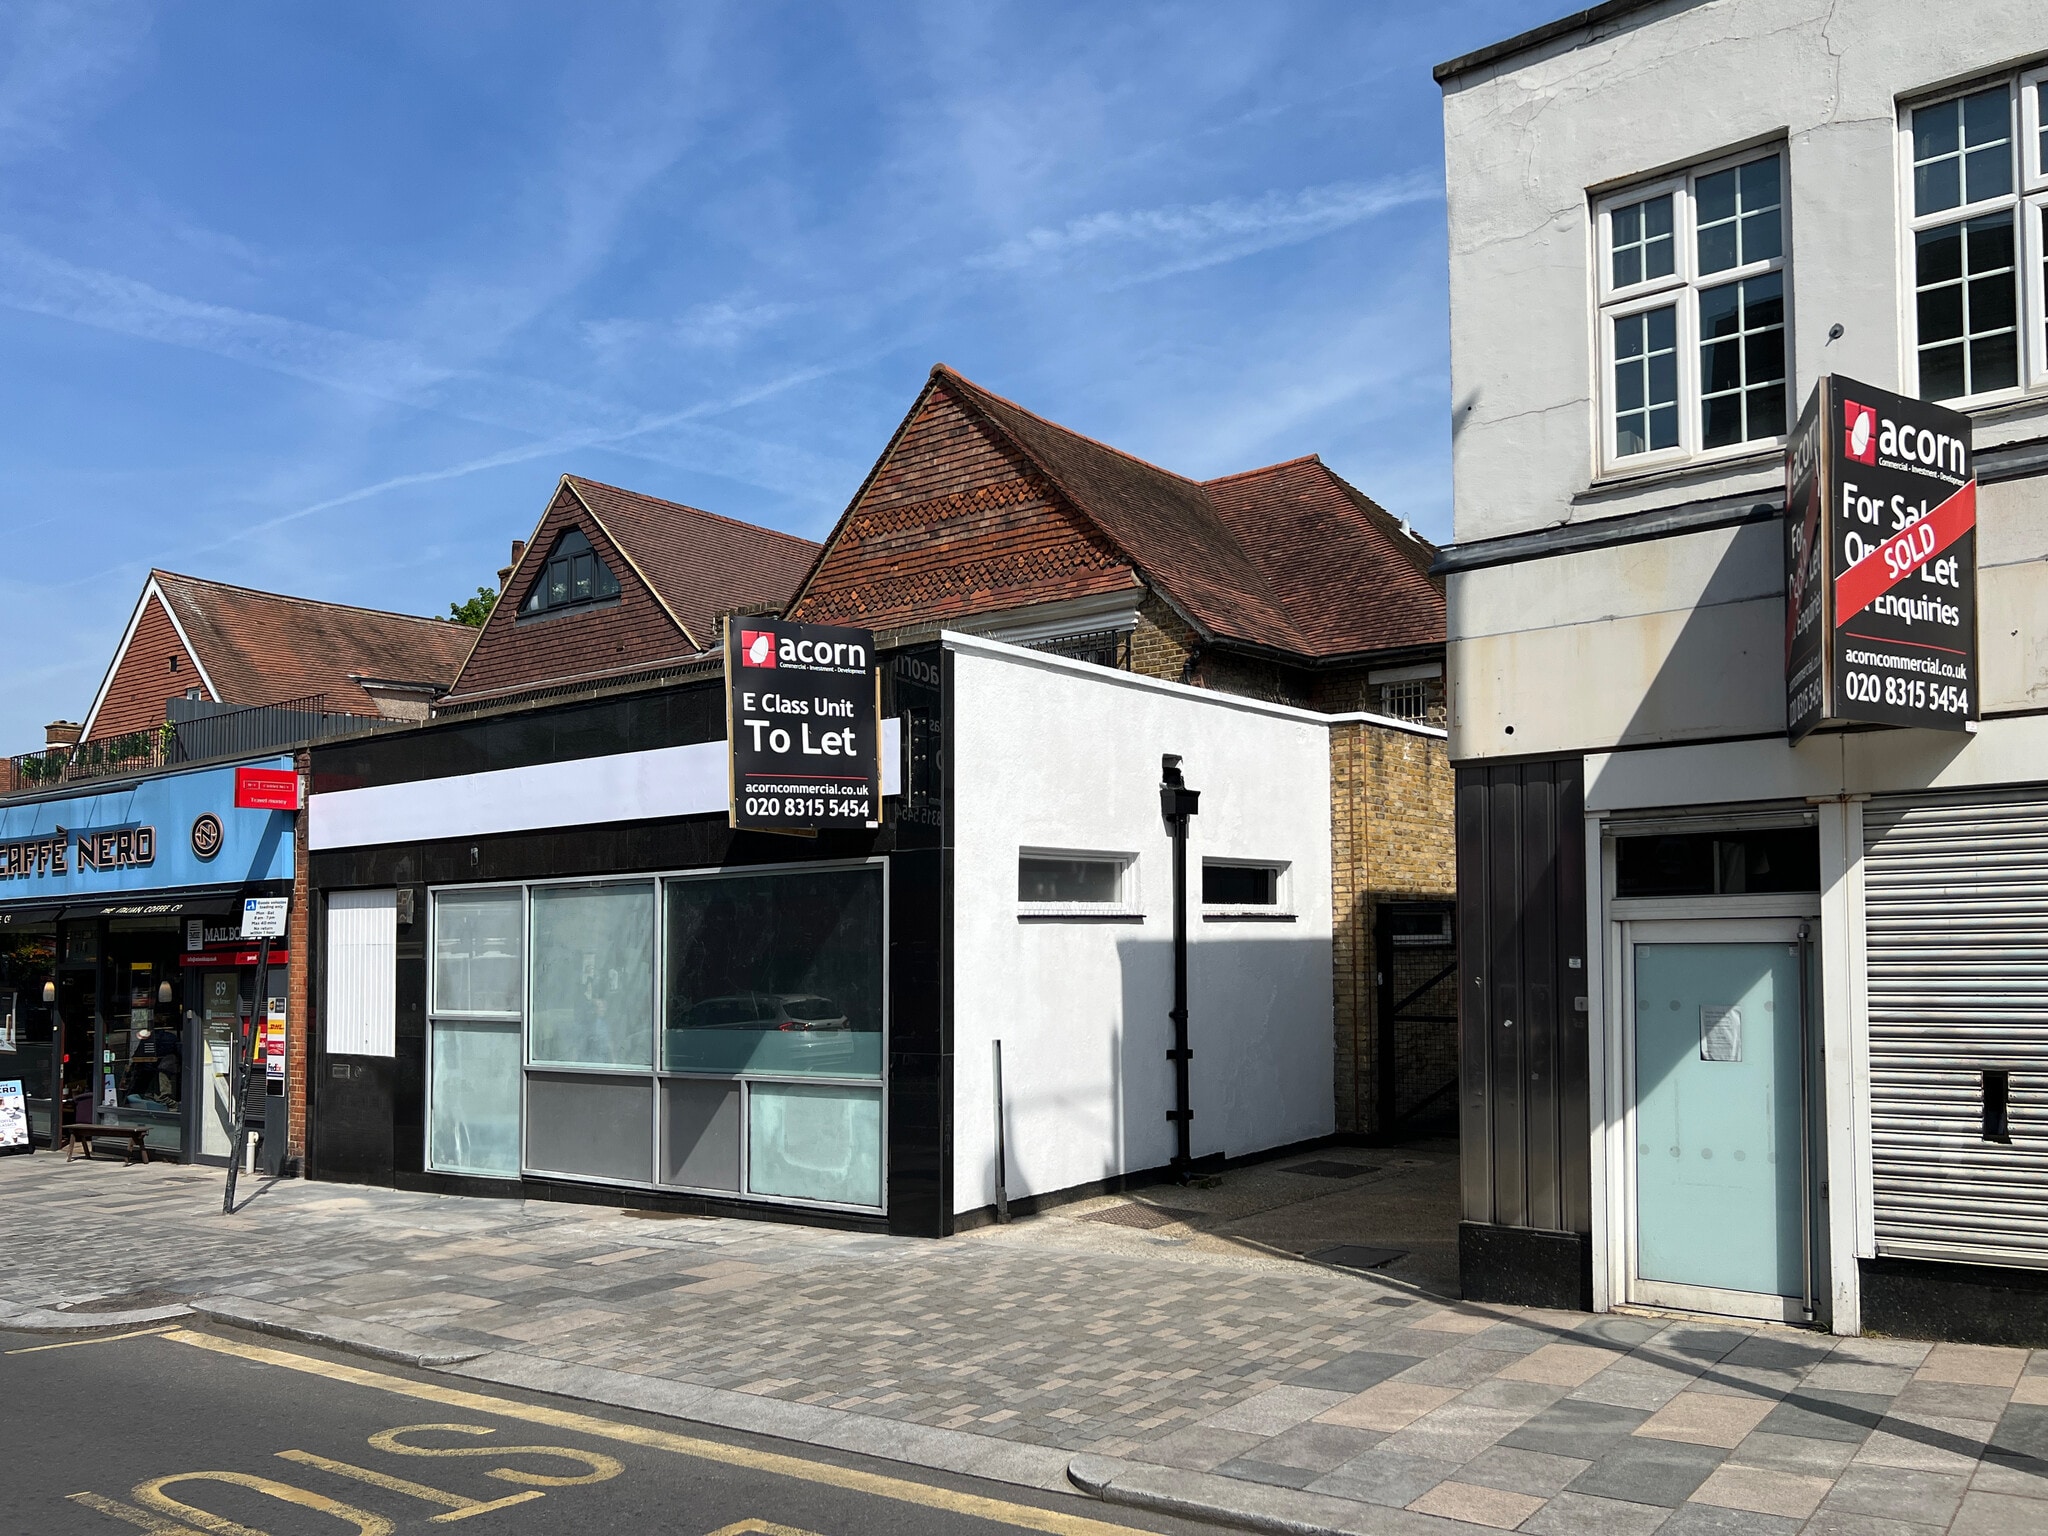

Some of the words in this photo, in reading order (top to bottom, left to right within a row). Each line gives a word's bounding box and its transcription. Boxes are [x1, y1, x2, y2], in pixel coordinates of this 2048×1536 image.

[1879, 418, 1965, 475] acorn
[1878, 457, 1908, 472] Commercial
[1911, 465, 1937, 478] Investment
[1843, 482, 1884, 525] For
[1884, 523, 1935, 579] SOLD
[1921, 555, 1959, 588] Let
[1874, 594, 1959, 627] Enquiries
[779, 638, 865, 667] acorn
[1845, 649, 1967, 680] acorncommercial.co.uk
[779, 662, 806, 670] Commercial
[809, 665, 834, 673] Investment
[837, 667, 866, 675] Development
[743, 692, 756, 711] E
[761, 693, 809, 715] Class
[814, 697, 854, 718] Unit
[1846, 671, 1881, 703] 020
[1885, 676, 1925, 709] 8315
[1929, 682, 1968, 715] 5454
[743, 719, 791, 753] To
[801, 722, 857, 756] Let
[745, 783, 869, 796] acorncommercial.co.uk
[745, 797, 780, 816] 020
[784, 798, 824, 817] 8315
[829, 799, 869, 817] 5454
[77, 825, 156, 870] NERO
[116, 906, 144, 914] ITALIAN
[143, 904, 171, 913] COFFEE
[204, 926, 228, 942] MAIL
[215, 981, 227, 996] 89
[268, 1063, 282, 1072] FedEx
